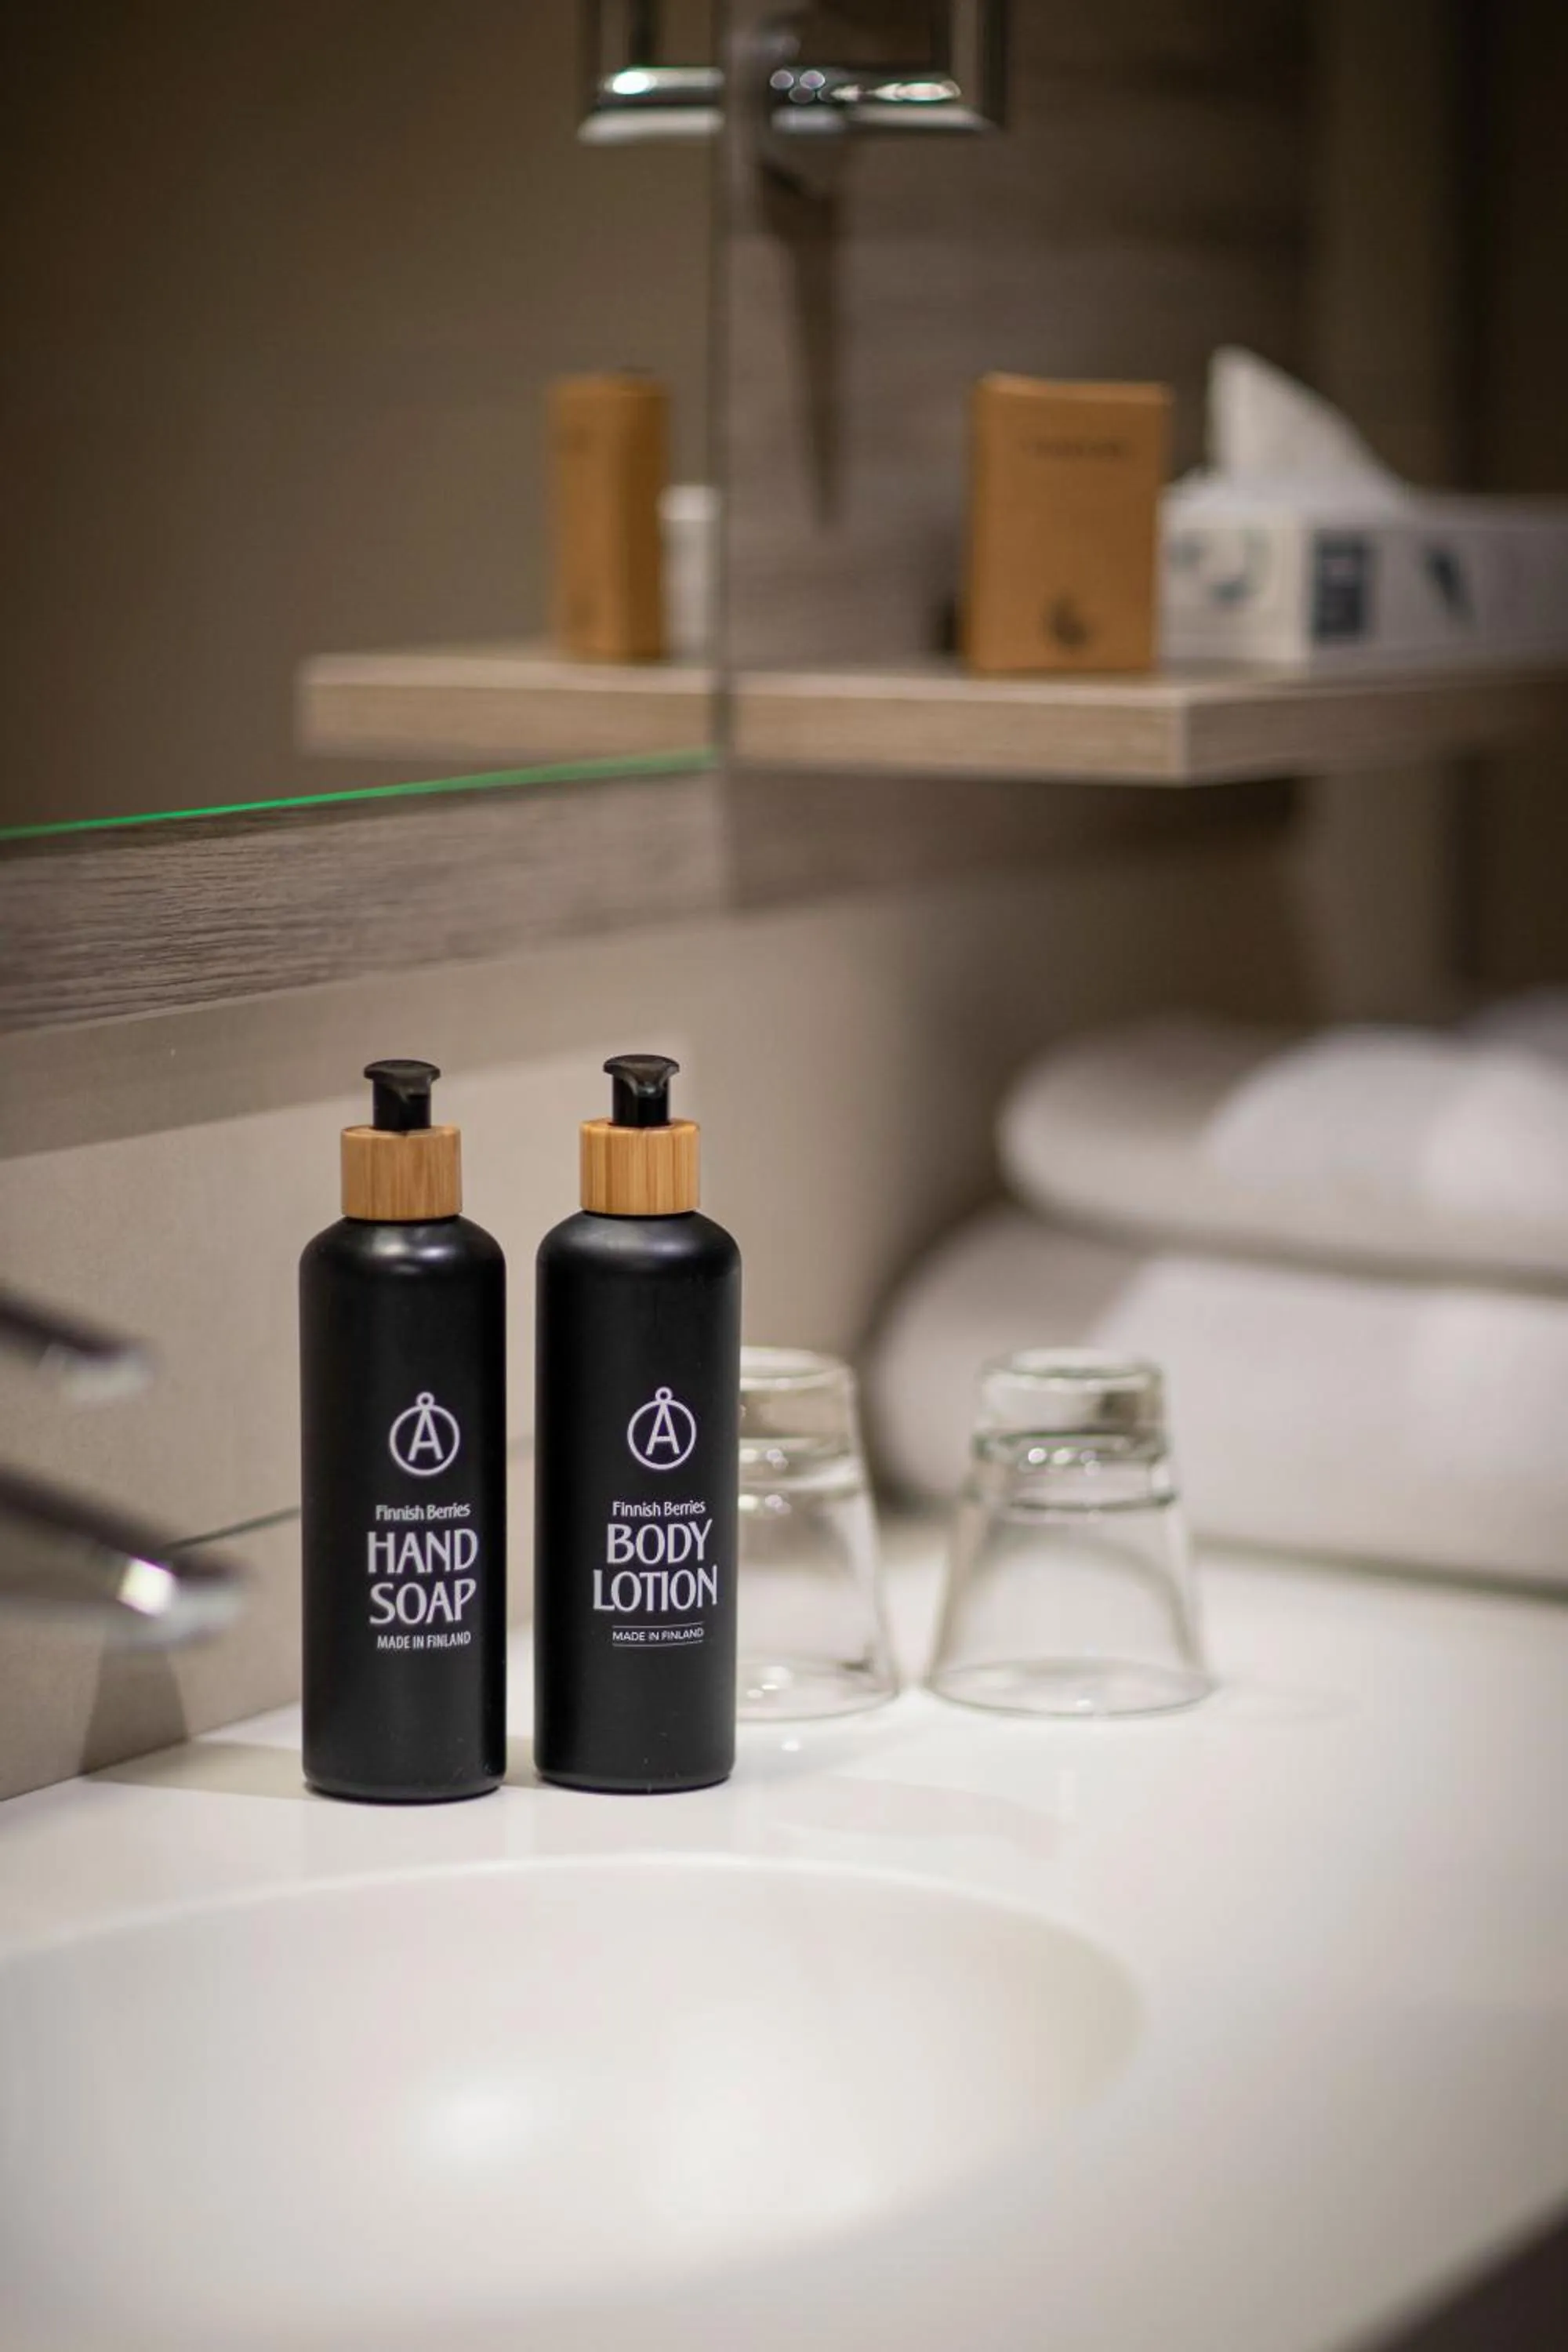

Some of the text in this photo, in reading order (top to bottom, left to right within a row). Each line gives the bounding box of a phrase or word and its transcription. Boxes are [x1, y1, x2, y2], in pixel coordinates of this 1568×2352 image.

[376, 1502, 471, 1521] Finnish Berries
[612, 1499, 706, 1517] Finnish Berries
[367, 1528, 478, 1574] HAND
[606, 1518, 713, 1565] BODY
[368, 1578, 477, 1625] SOAP
[593, 1564, 718, 1613] LOTION
[377, 1631, 471, 1650] MADE IN FINLAND
[612, 1627, 704, 1642] MADE IN FINLAND
